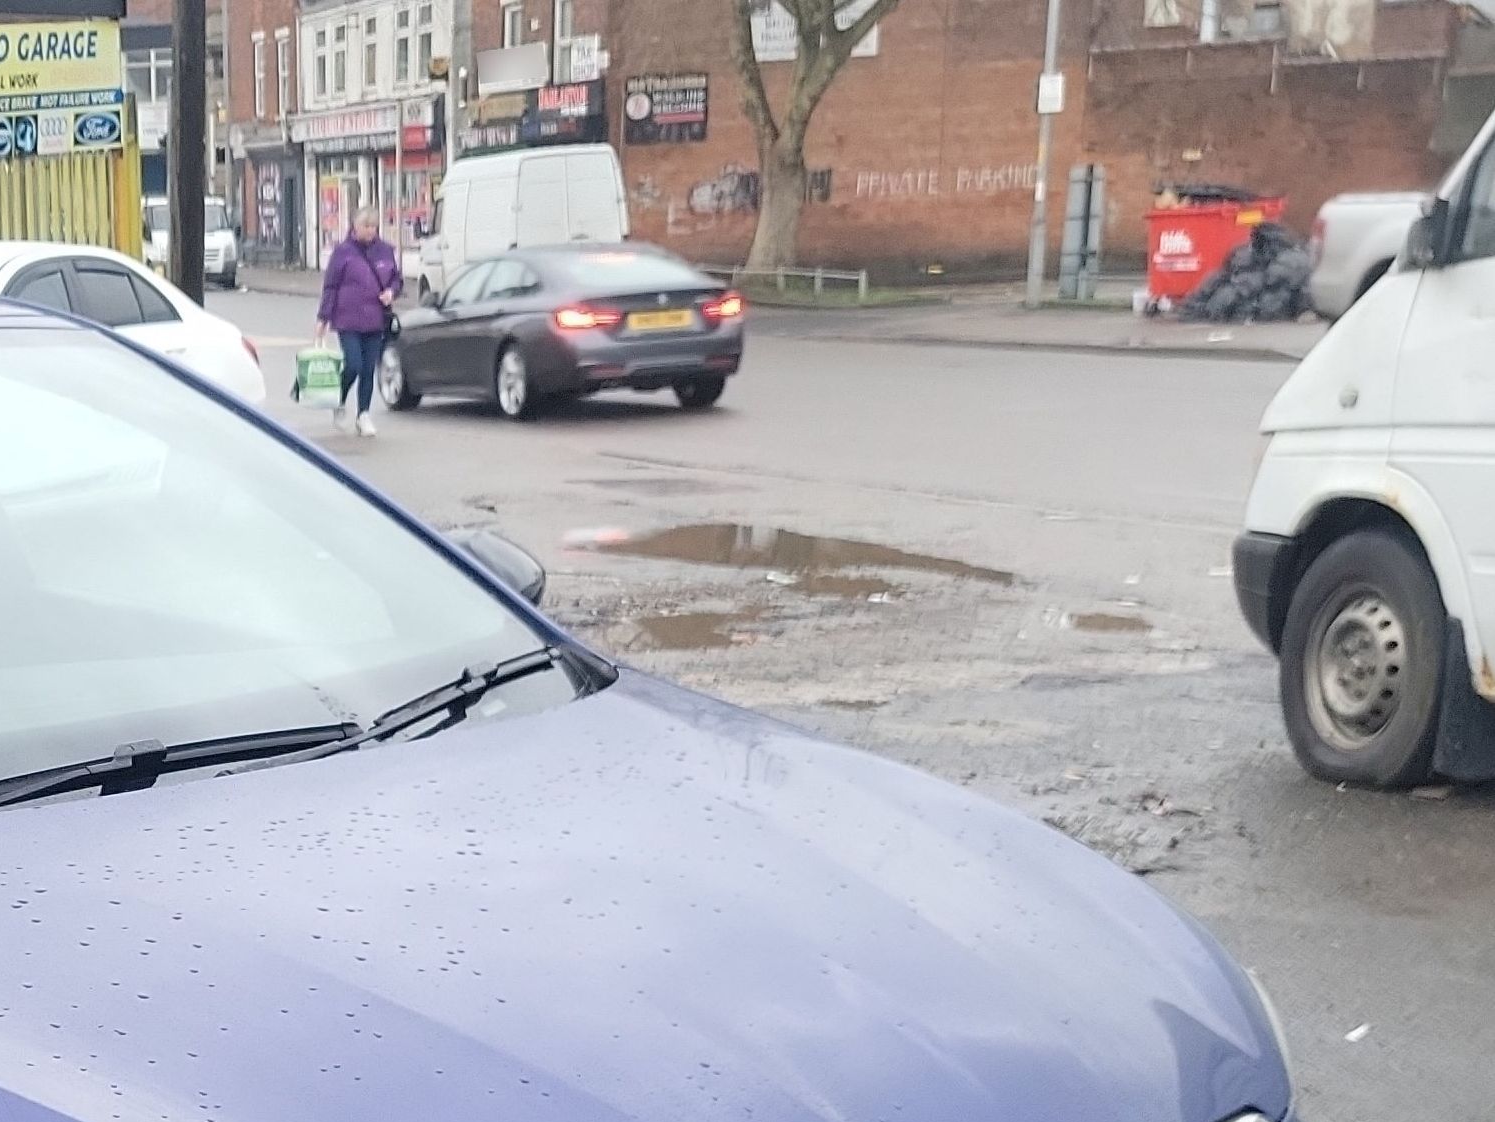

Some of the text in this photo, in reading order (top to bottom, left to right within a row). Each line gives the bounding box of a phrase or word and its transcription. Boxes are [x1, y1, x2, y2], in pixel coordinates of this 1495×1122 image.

[17, 30, 98, 61] GARAGE
[8, 73, 39, 89] WORK
[856, 169, 940, 199] PRIVATE
